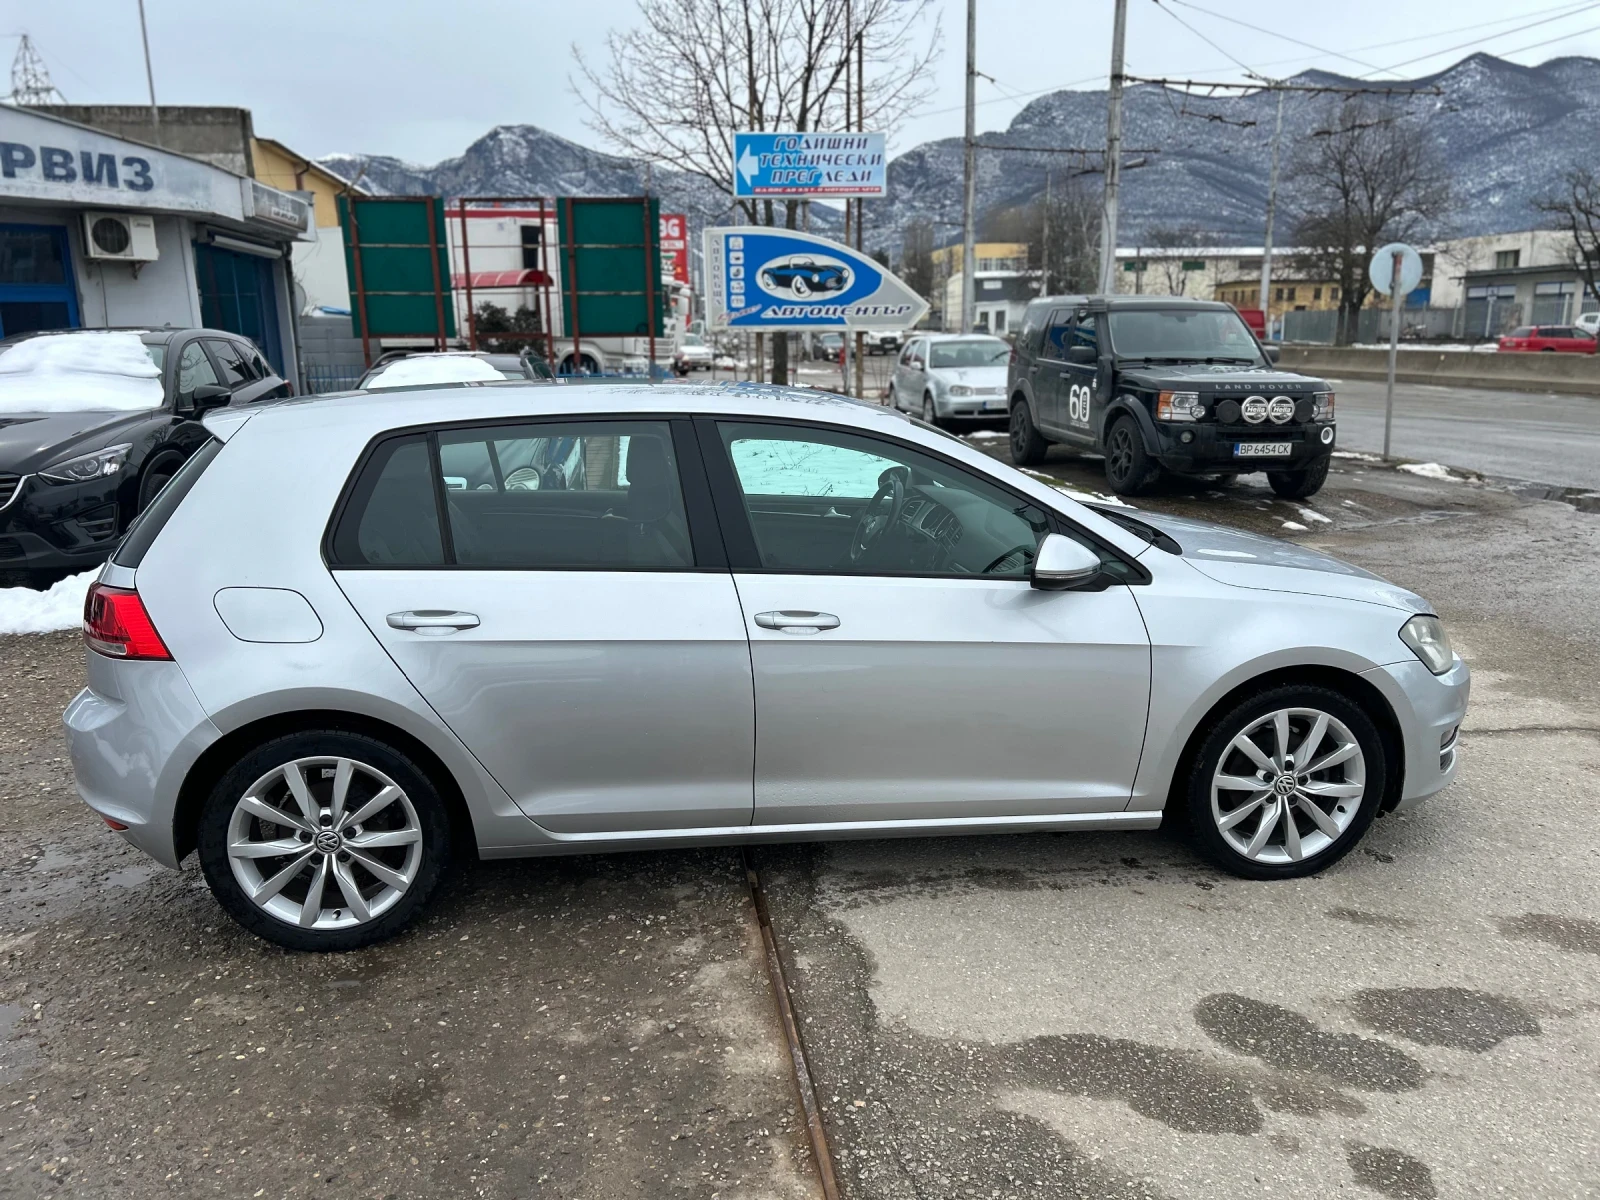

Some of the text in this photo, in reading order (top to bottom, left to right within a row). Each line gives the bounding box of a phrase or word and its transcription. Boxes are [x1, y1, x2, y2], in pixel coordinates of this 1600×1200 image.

[774, 137, 868, 150] ГОДИШНИ
[760, 153, 882, 166] ТЕХНИЧЕСКИ
[0, 141, 154, 192] РВИЗ
[771, 170, 872, 183] ПРЕГЛЕДИ
[763, 306, 911, 318] АВТОЦЕНТЪР
[1069, 384, 1090, 422] 60
[1240, 444, 1289, 454] BP 6454 CK
